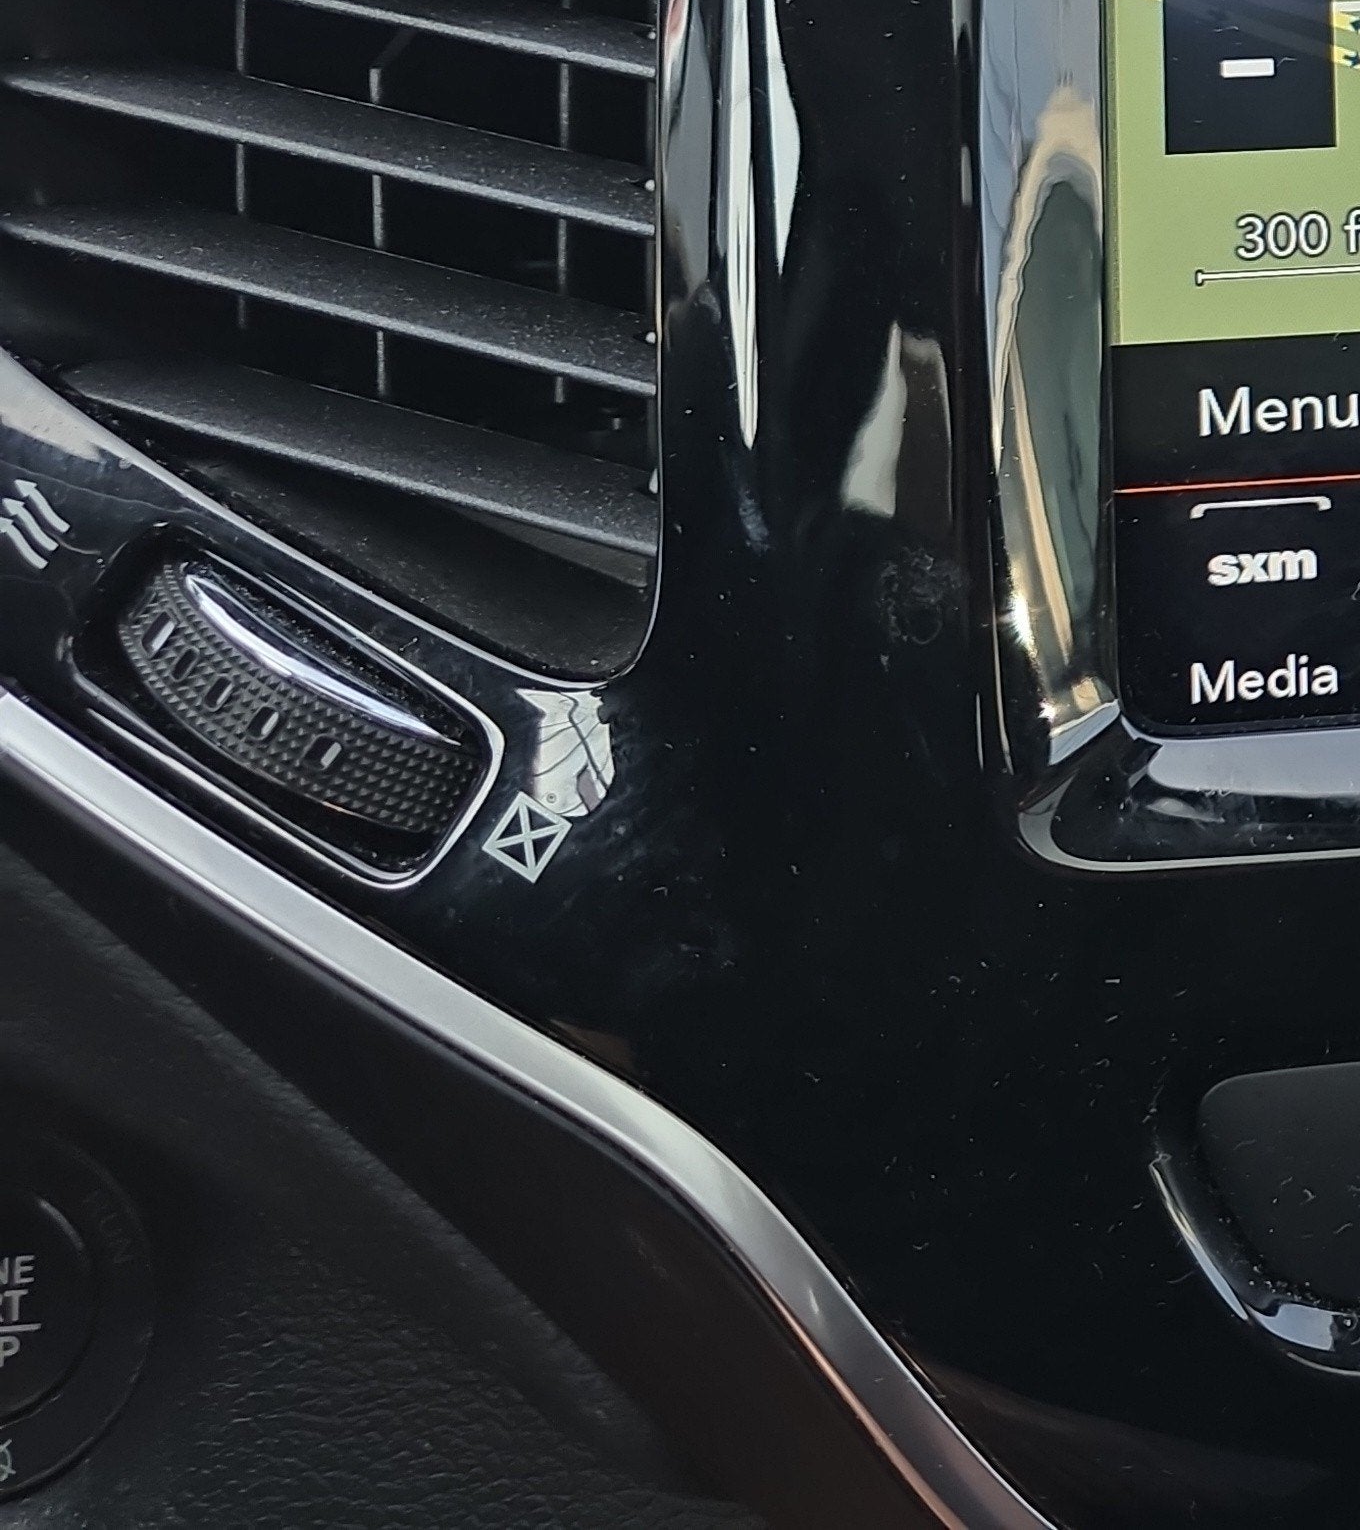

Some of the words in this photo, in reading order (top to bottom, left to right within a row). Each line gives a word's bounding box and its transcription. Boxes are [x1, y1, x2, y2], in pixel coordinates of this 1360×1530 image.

[1236, 212, 1329, 259] 300
[1198, 386, 1360, 437] Menu
[1207, 549, 1318, 586] sxm
[1190, 653, 1339, 705] Media
